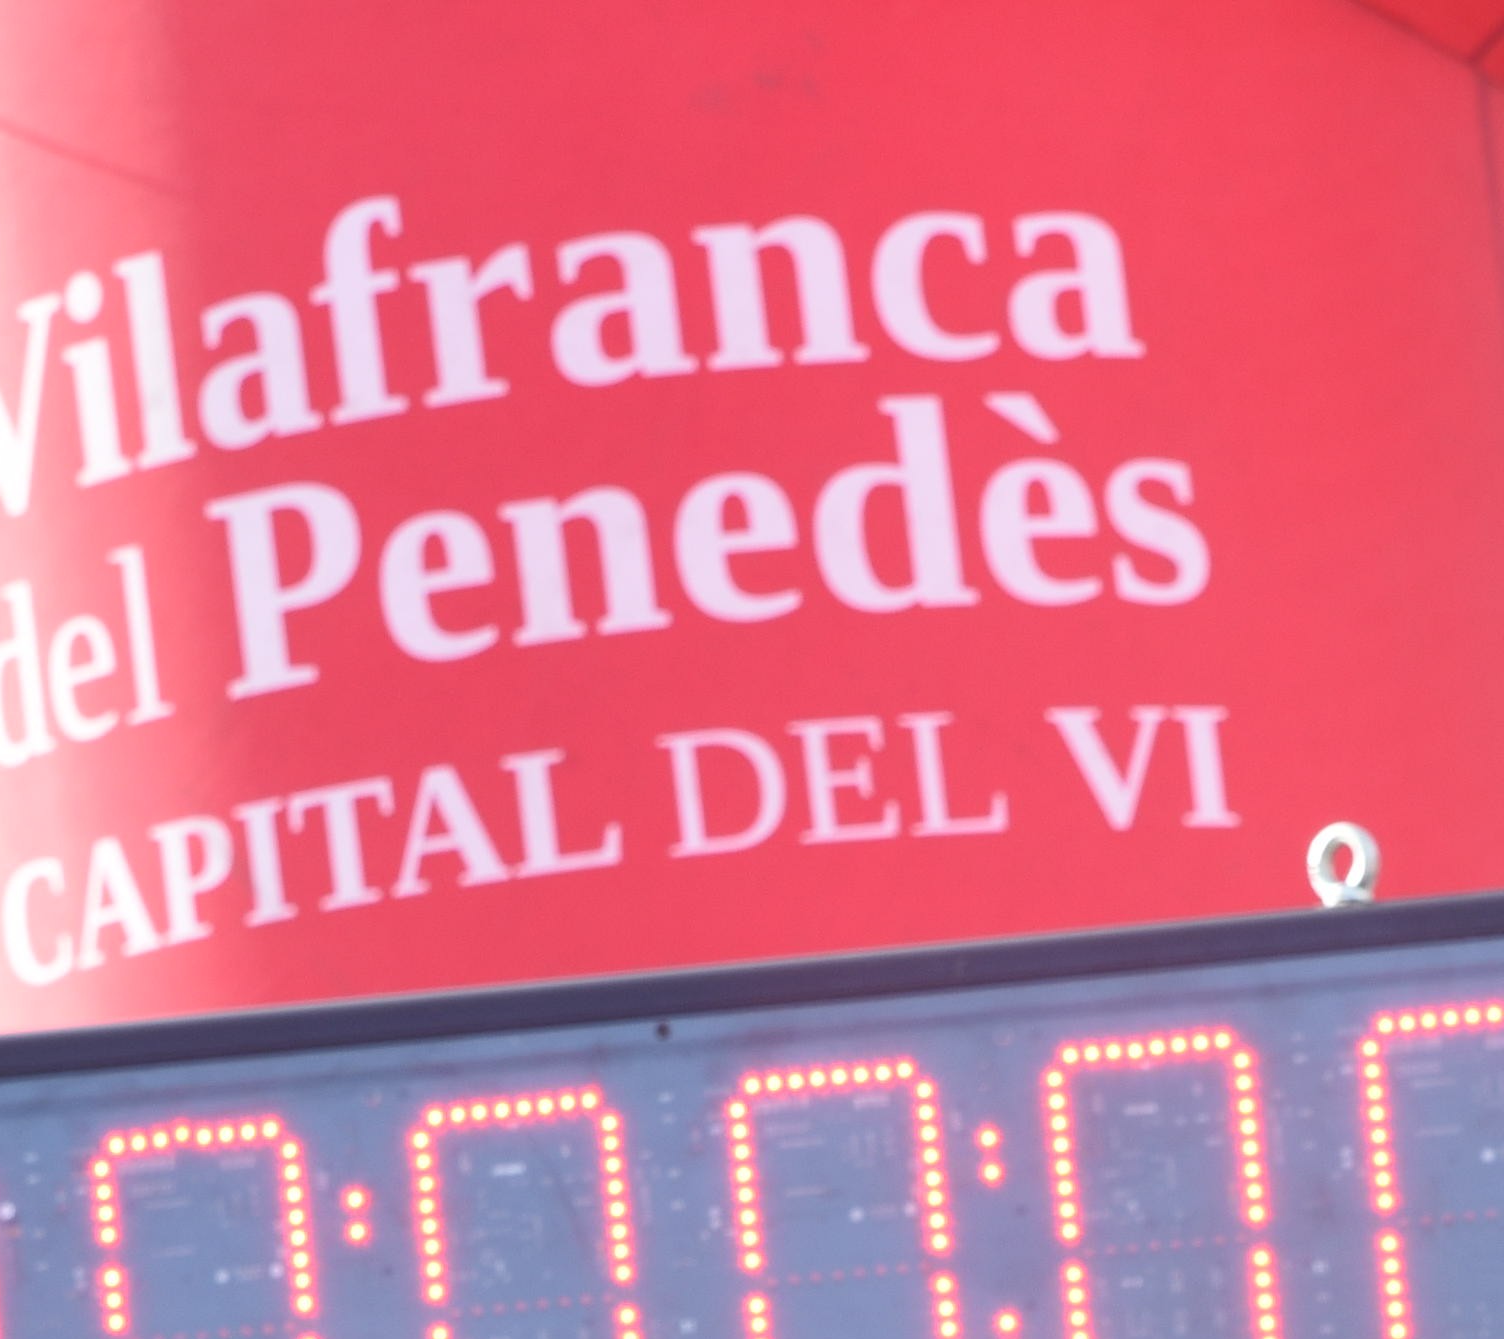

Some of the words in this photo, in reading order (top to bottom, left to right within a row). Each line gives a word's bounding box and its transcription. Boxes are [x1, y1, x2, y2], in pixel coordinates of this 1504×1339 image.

[203, 389, 1213, 701] Penedès
[654, 709, 1009, 860] DEL
[1043, 704, 1243, 832] VI
